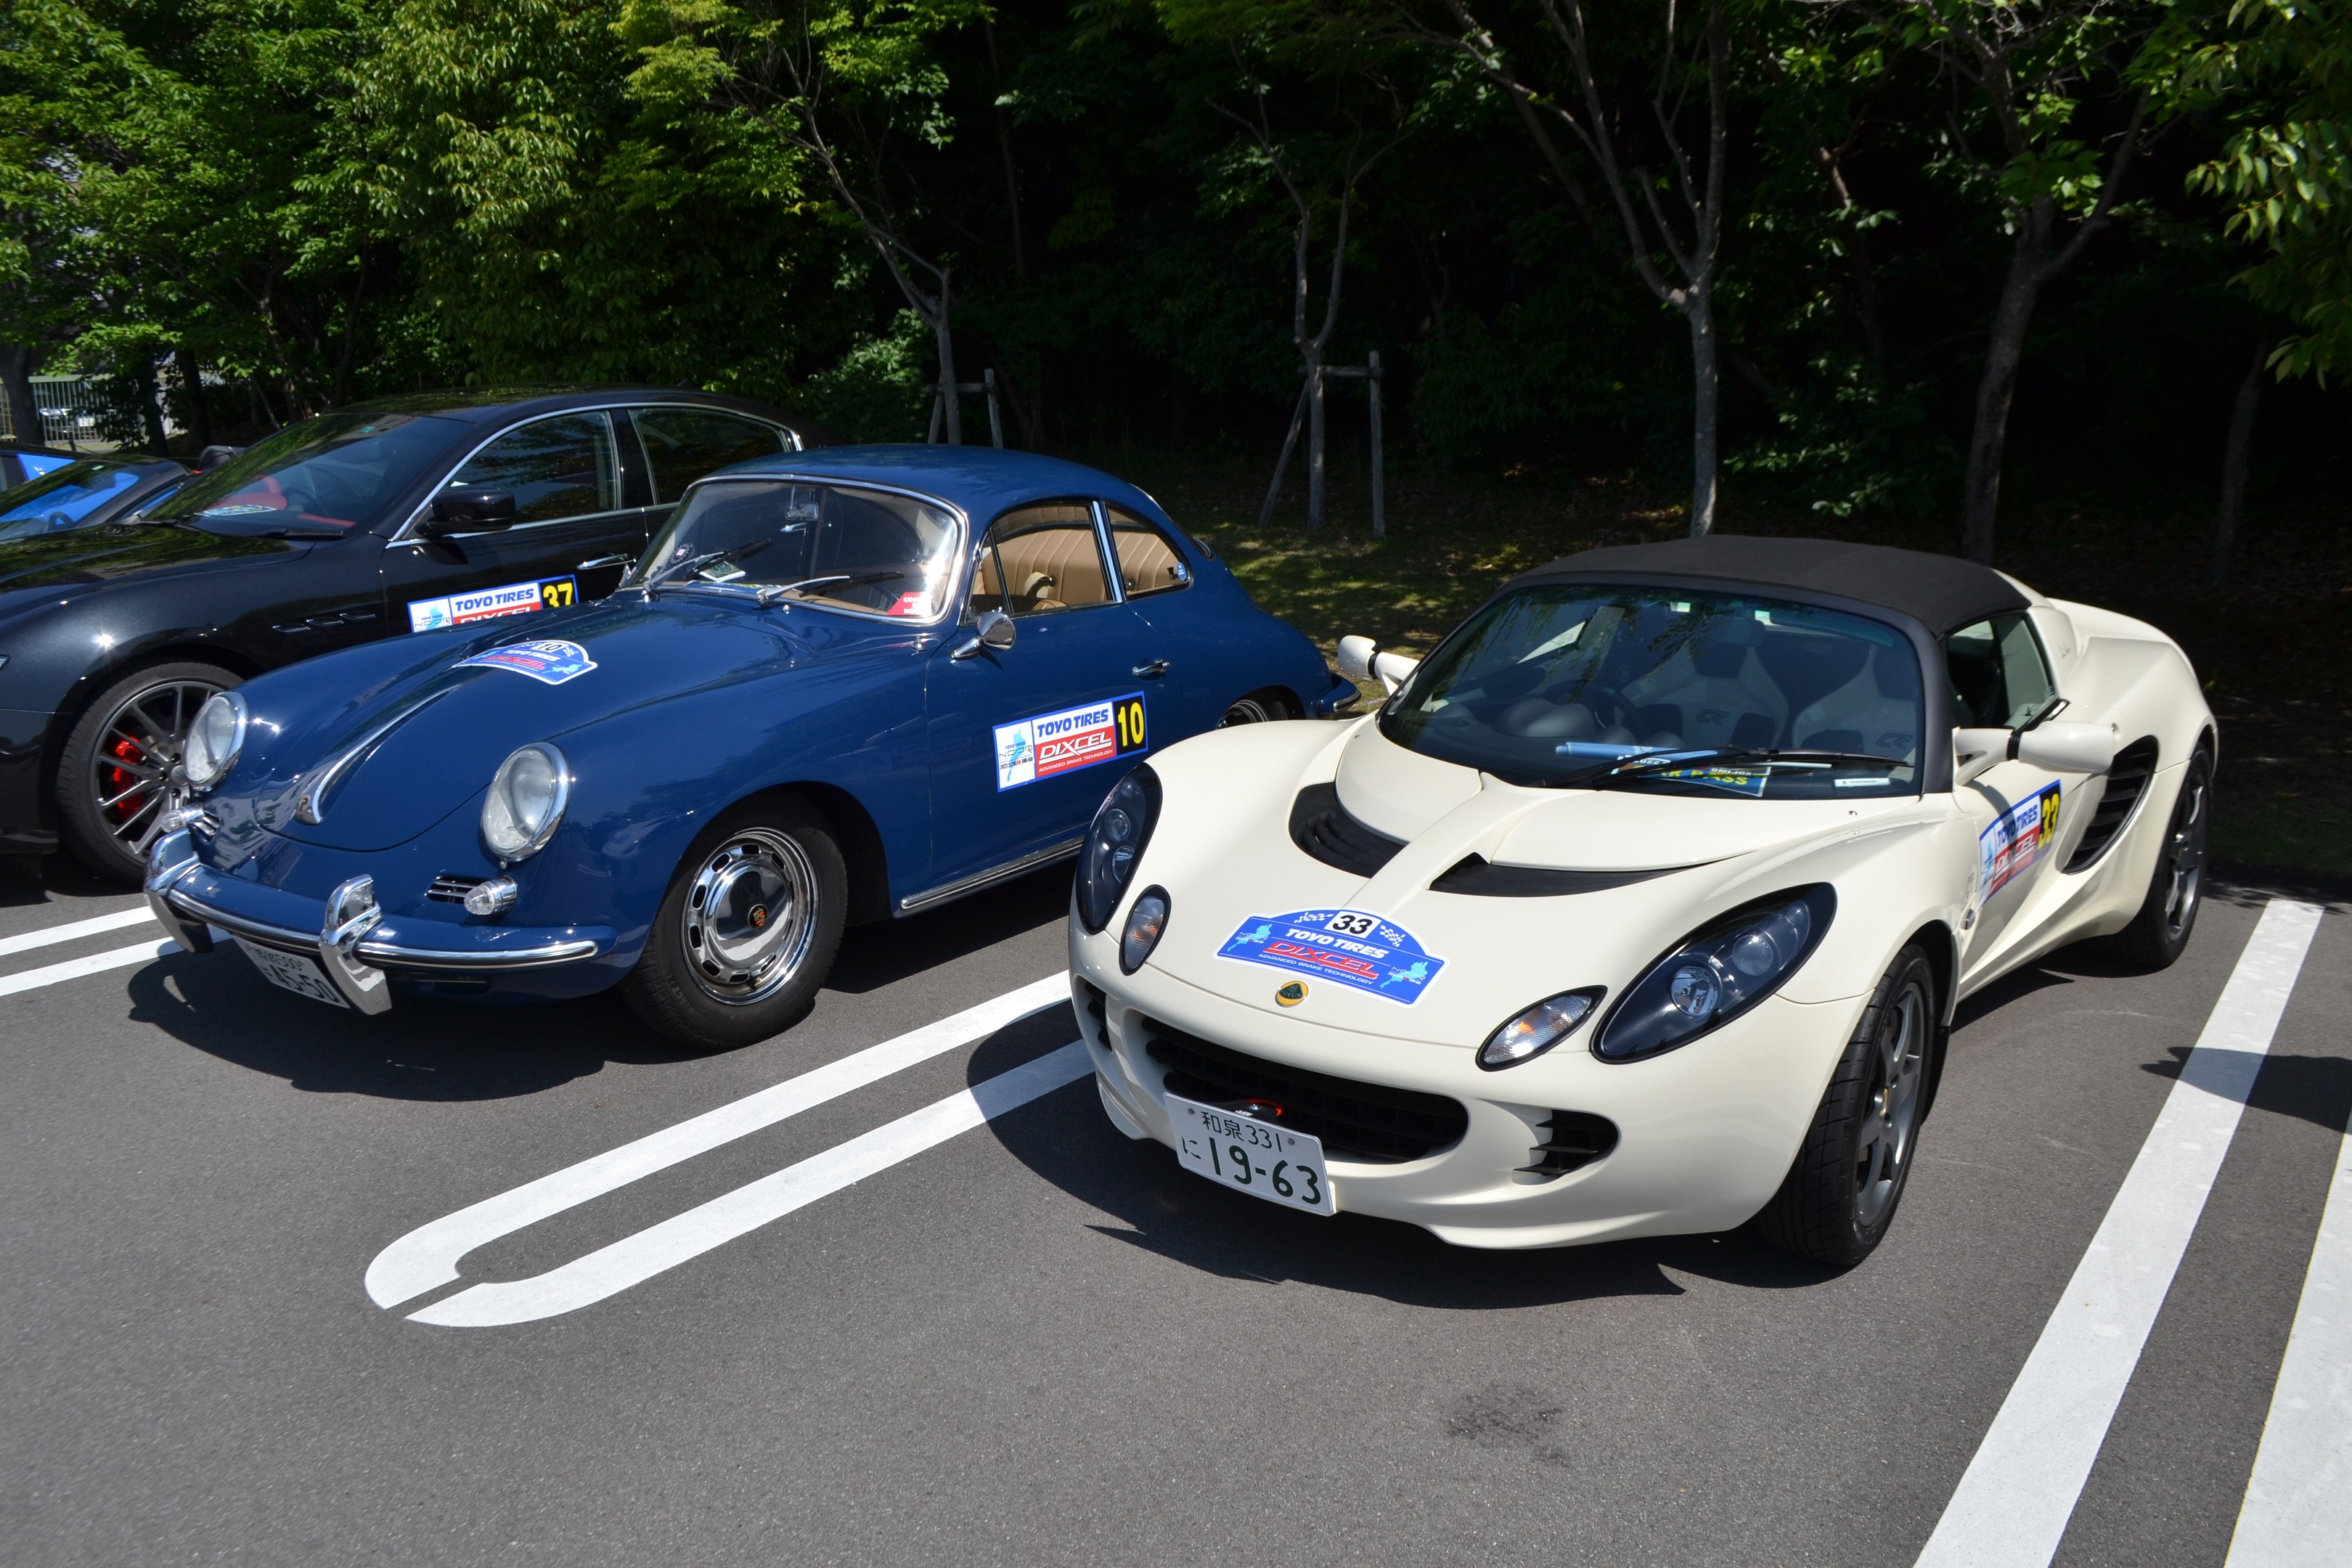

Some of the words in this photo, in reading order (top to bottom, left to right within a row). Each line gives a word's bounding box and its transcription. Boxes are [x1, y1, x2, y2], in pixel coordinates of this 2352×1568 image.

[454, 597, 493, 611] TOYO
[494, 589, 534, 605] TIRES
[543, 582, 573, 608] 37
[1037, 720, 1072, 738] TOYO
[1074, 709, 1109, 729] TIRES
[1118, 702, 1144, 747] 10
[1039, 731, 1112, 762] DIXCEL
[1039, 762, 1066, 772] ADVANCED
[1083, 749, 1113, 761] TECHNOLOGY
[1997, 819, 2017, 847] TOYO
[2015, 804, 2038, 832] TIRES
[2037, 793, 2061, 850] 33
[1332, 915, 1373, 934] 33
[1285, 928, 1334, 945] TOYO
[1333, 939, 1389, 960] TIRES
[1258, 953, 1297, 965] ADVANCED
[1298, 962, 1323, 972] BRAKE
[1324, 968, 1374, 985] TECHNOLOGY
[1264, 942, 1379, 979] DIXCEL
[1181, 1136, 1201, 1159] に
[1209, 1137, 1321, 1205] 19-63
